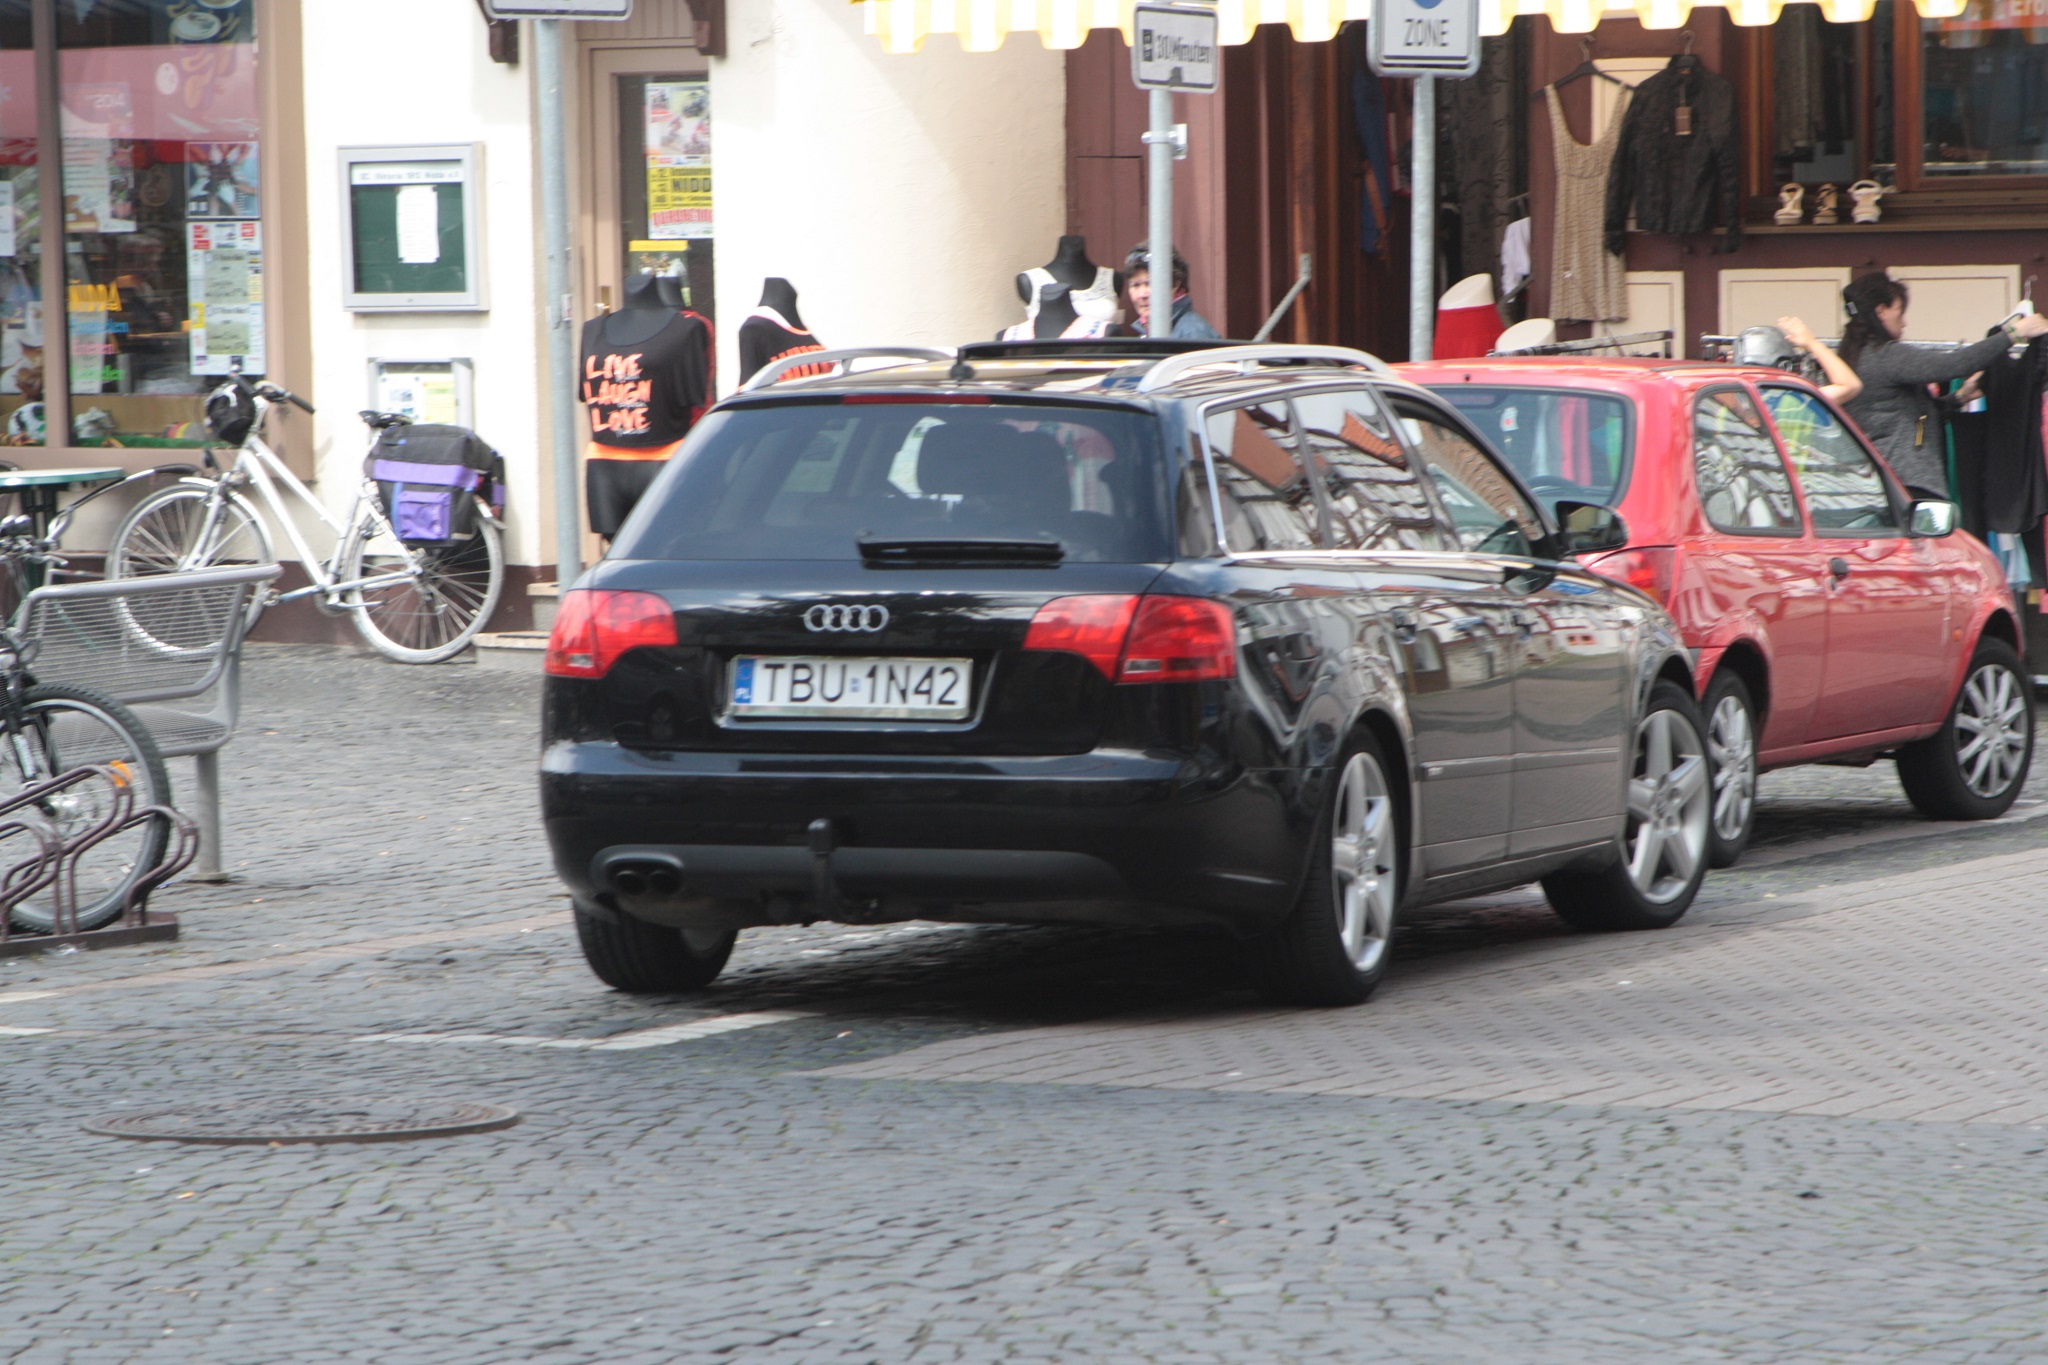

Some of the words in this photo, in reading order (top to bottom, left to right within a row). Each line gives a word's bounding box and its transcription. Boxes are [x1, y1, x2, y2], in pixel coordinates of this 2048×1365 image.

[1403, 18, 1449, 47] ZONE
[1156, 33, 1171, 60] 30
[1172, 36, 1211, 63] Minuten
[585, 353, 643, 380] LIVE
[591, 407, 652, 433] LOVE
[763, 663, 847, 703] TBU
[865, 664, 960, 705] 1N42
